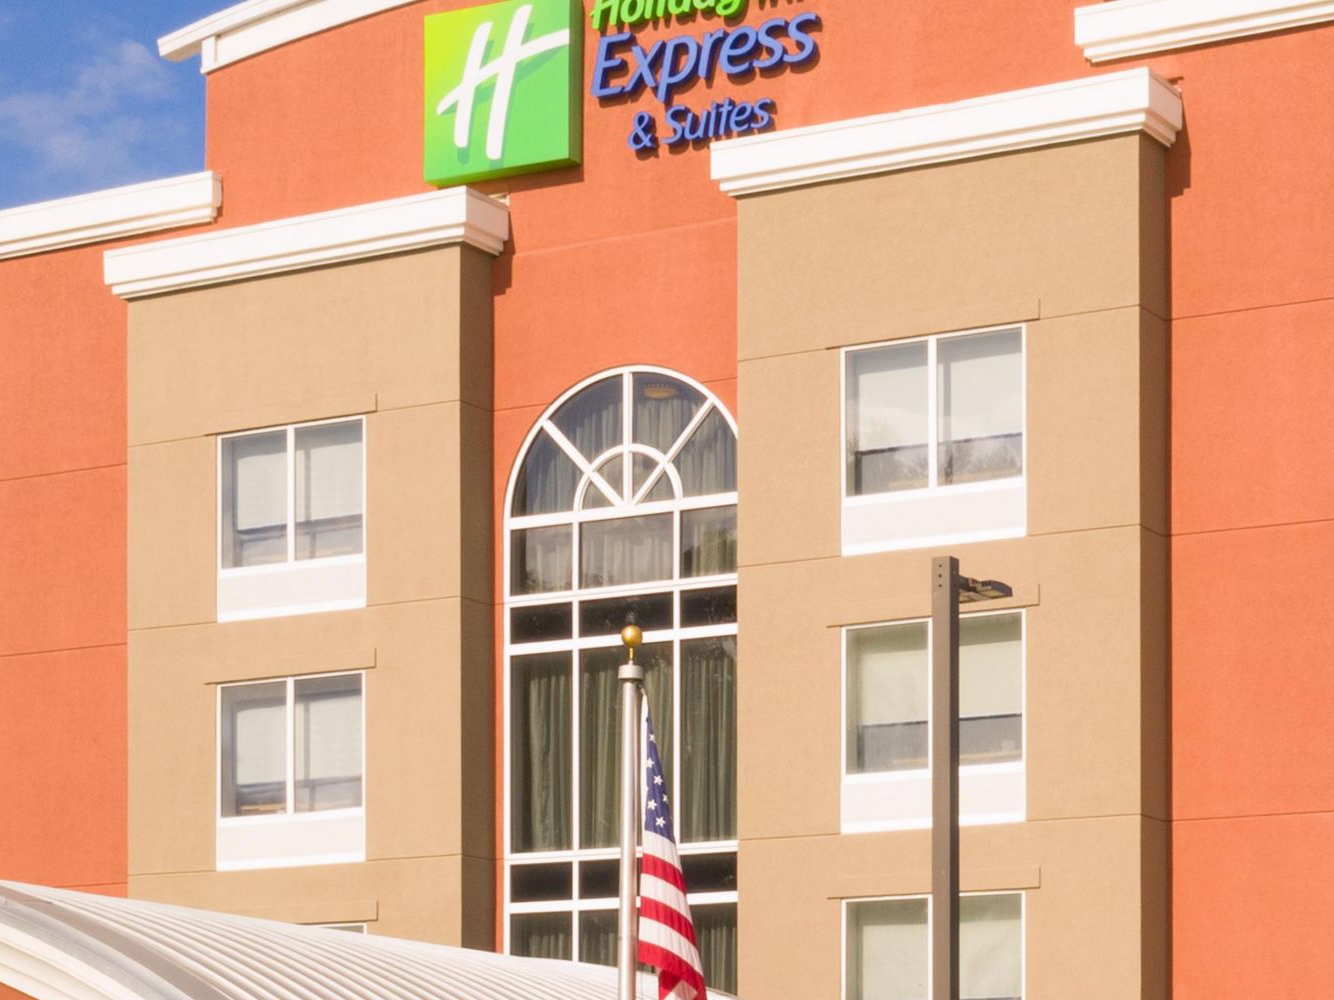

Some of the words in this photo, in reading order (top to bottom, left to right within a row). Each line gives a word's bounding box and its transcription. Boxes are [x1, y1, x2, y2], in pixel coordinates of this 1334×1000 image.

[591, 12, 818, 103] Express
[628, 111, 656, 150] &
[661, 98, 773, 144] Suites
